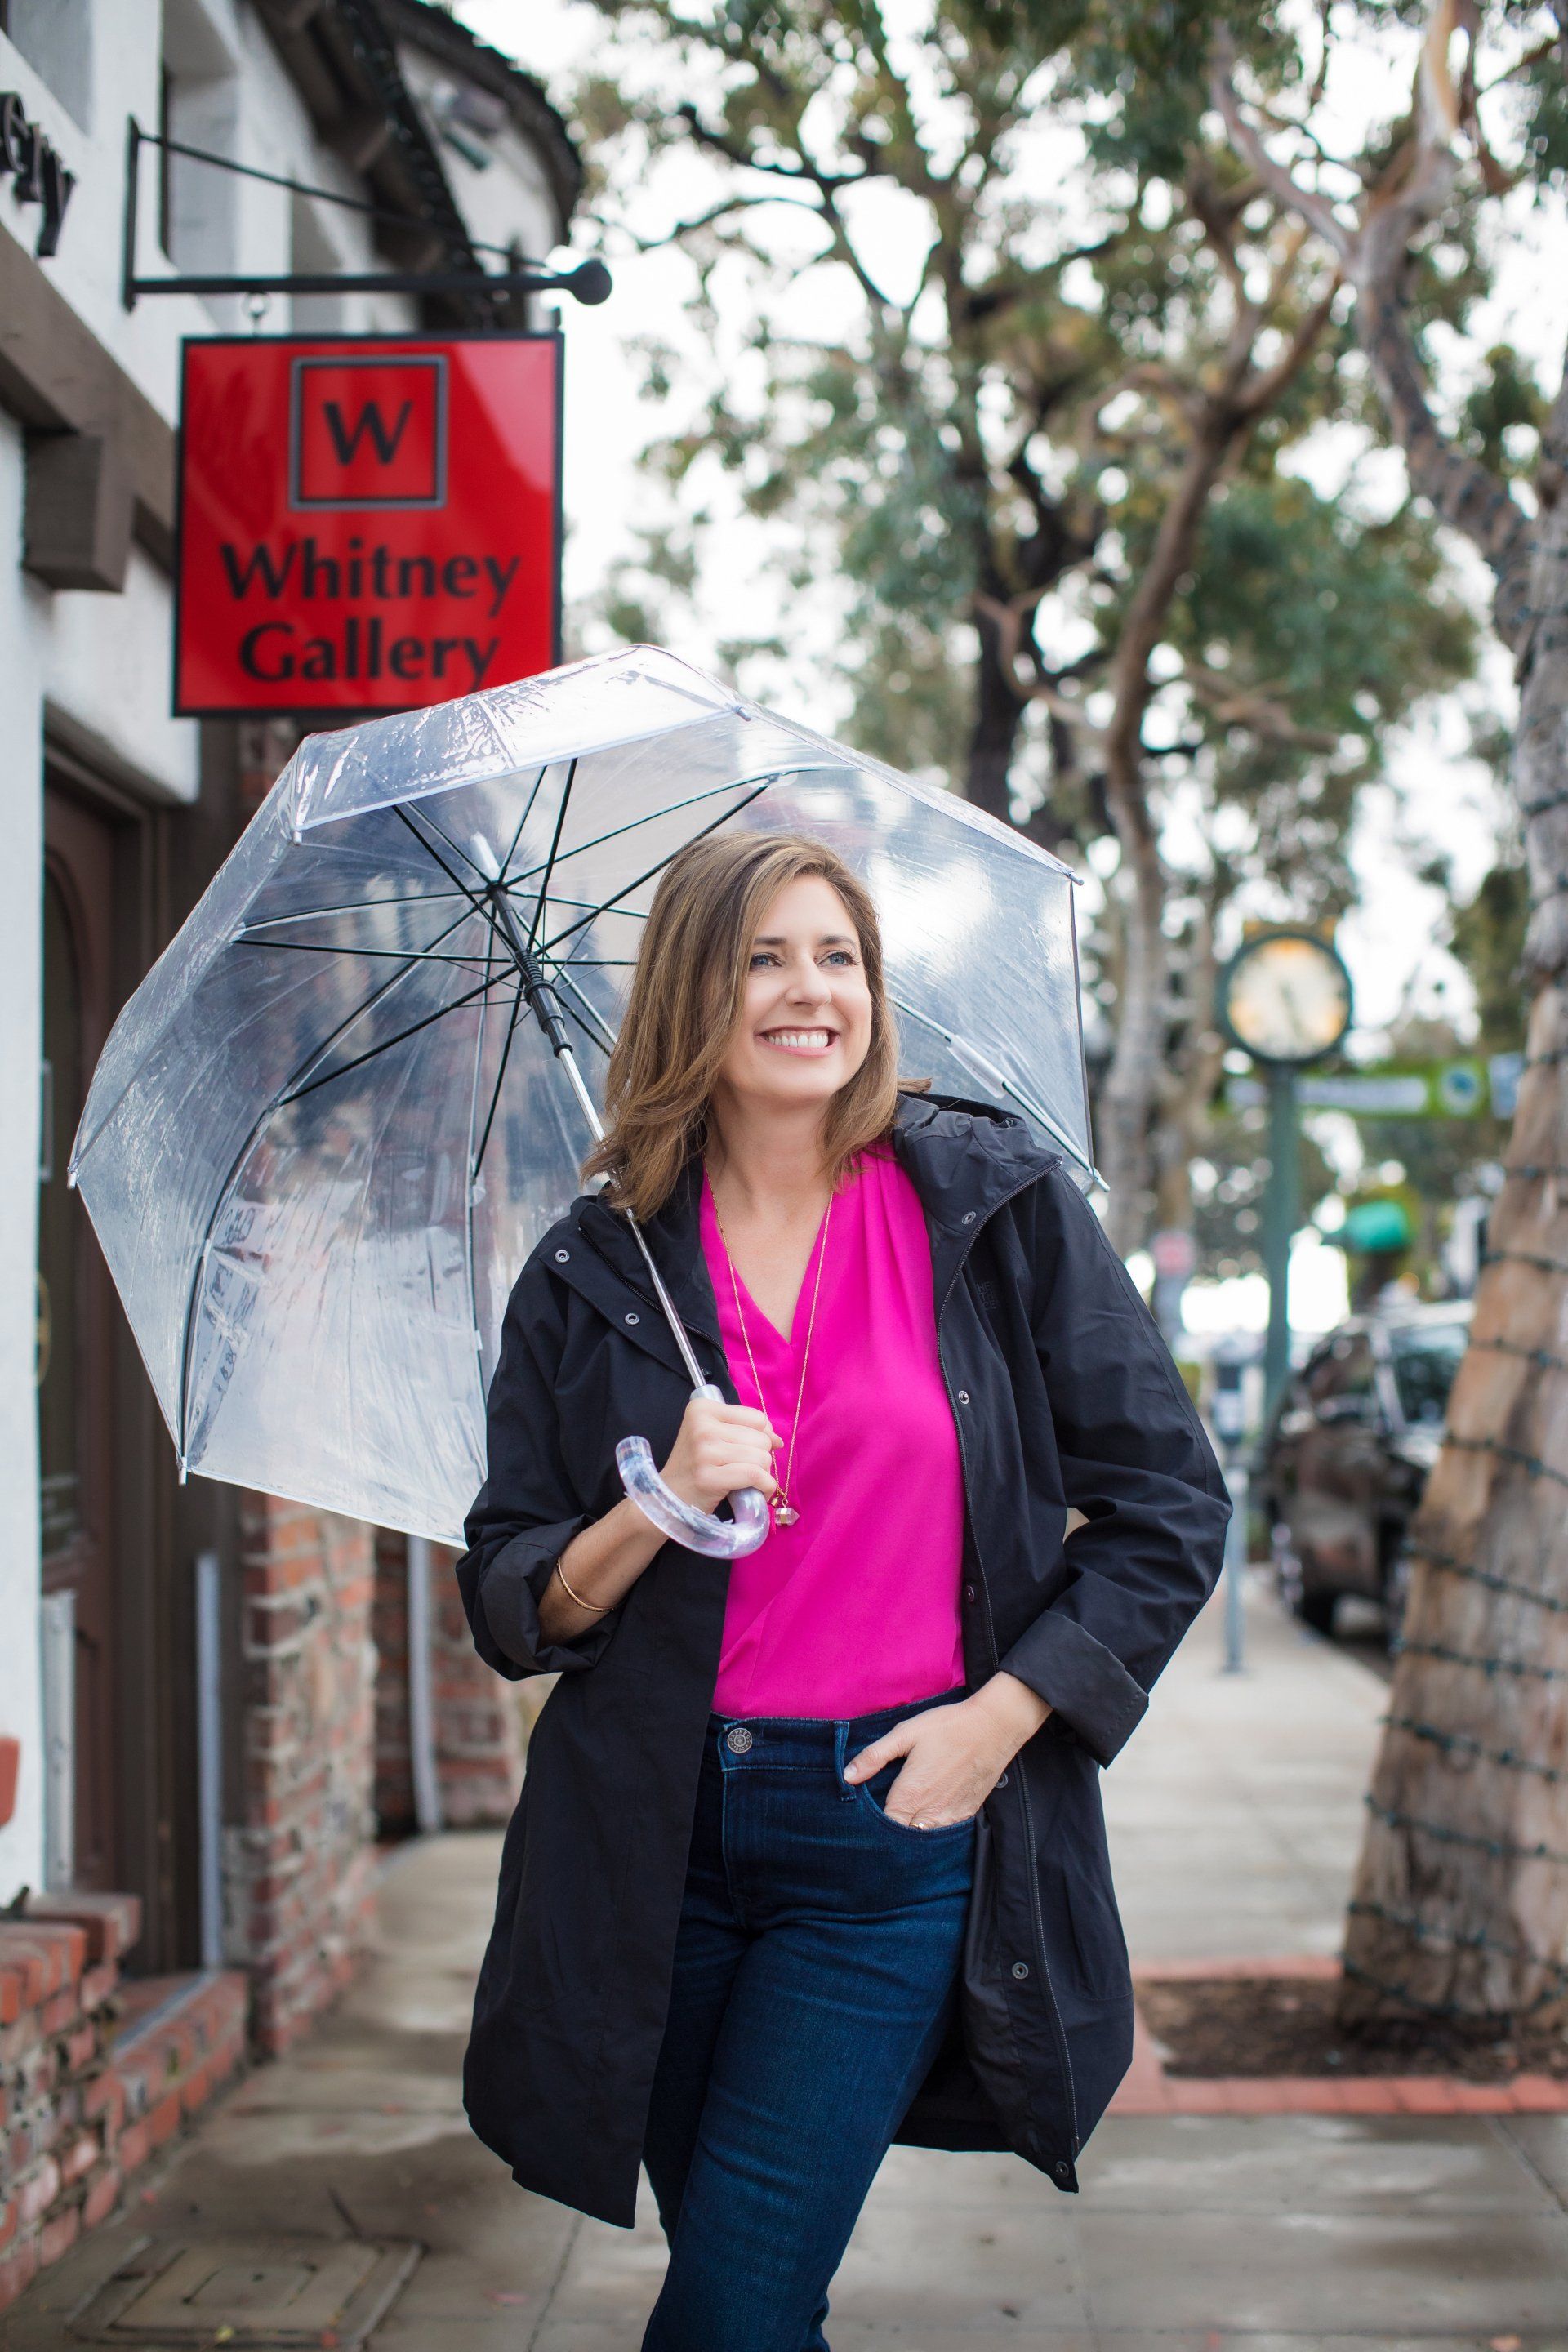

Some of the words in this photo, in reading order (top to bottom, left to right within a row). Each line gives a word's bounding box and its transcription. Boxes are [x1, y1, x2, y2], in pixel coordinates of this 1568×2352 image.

[323, 399, 412, 466] W
[220, 537, 520, 618] Whitney
[238, 617, 499, 693] Gallery
